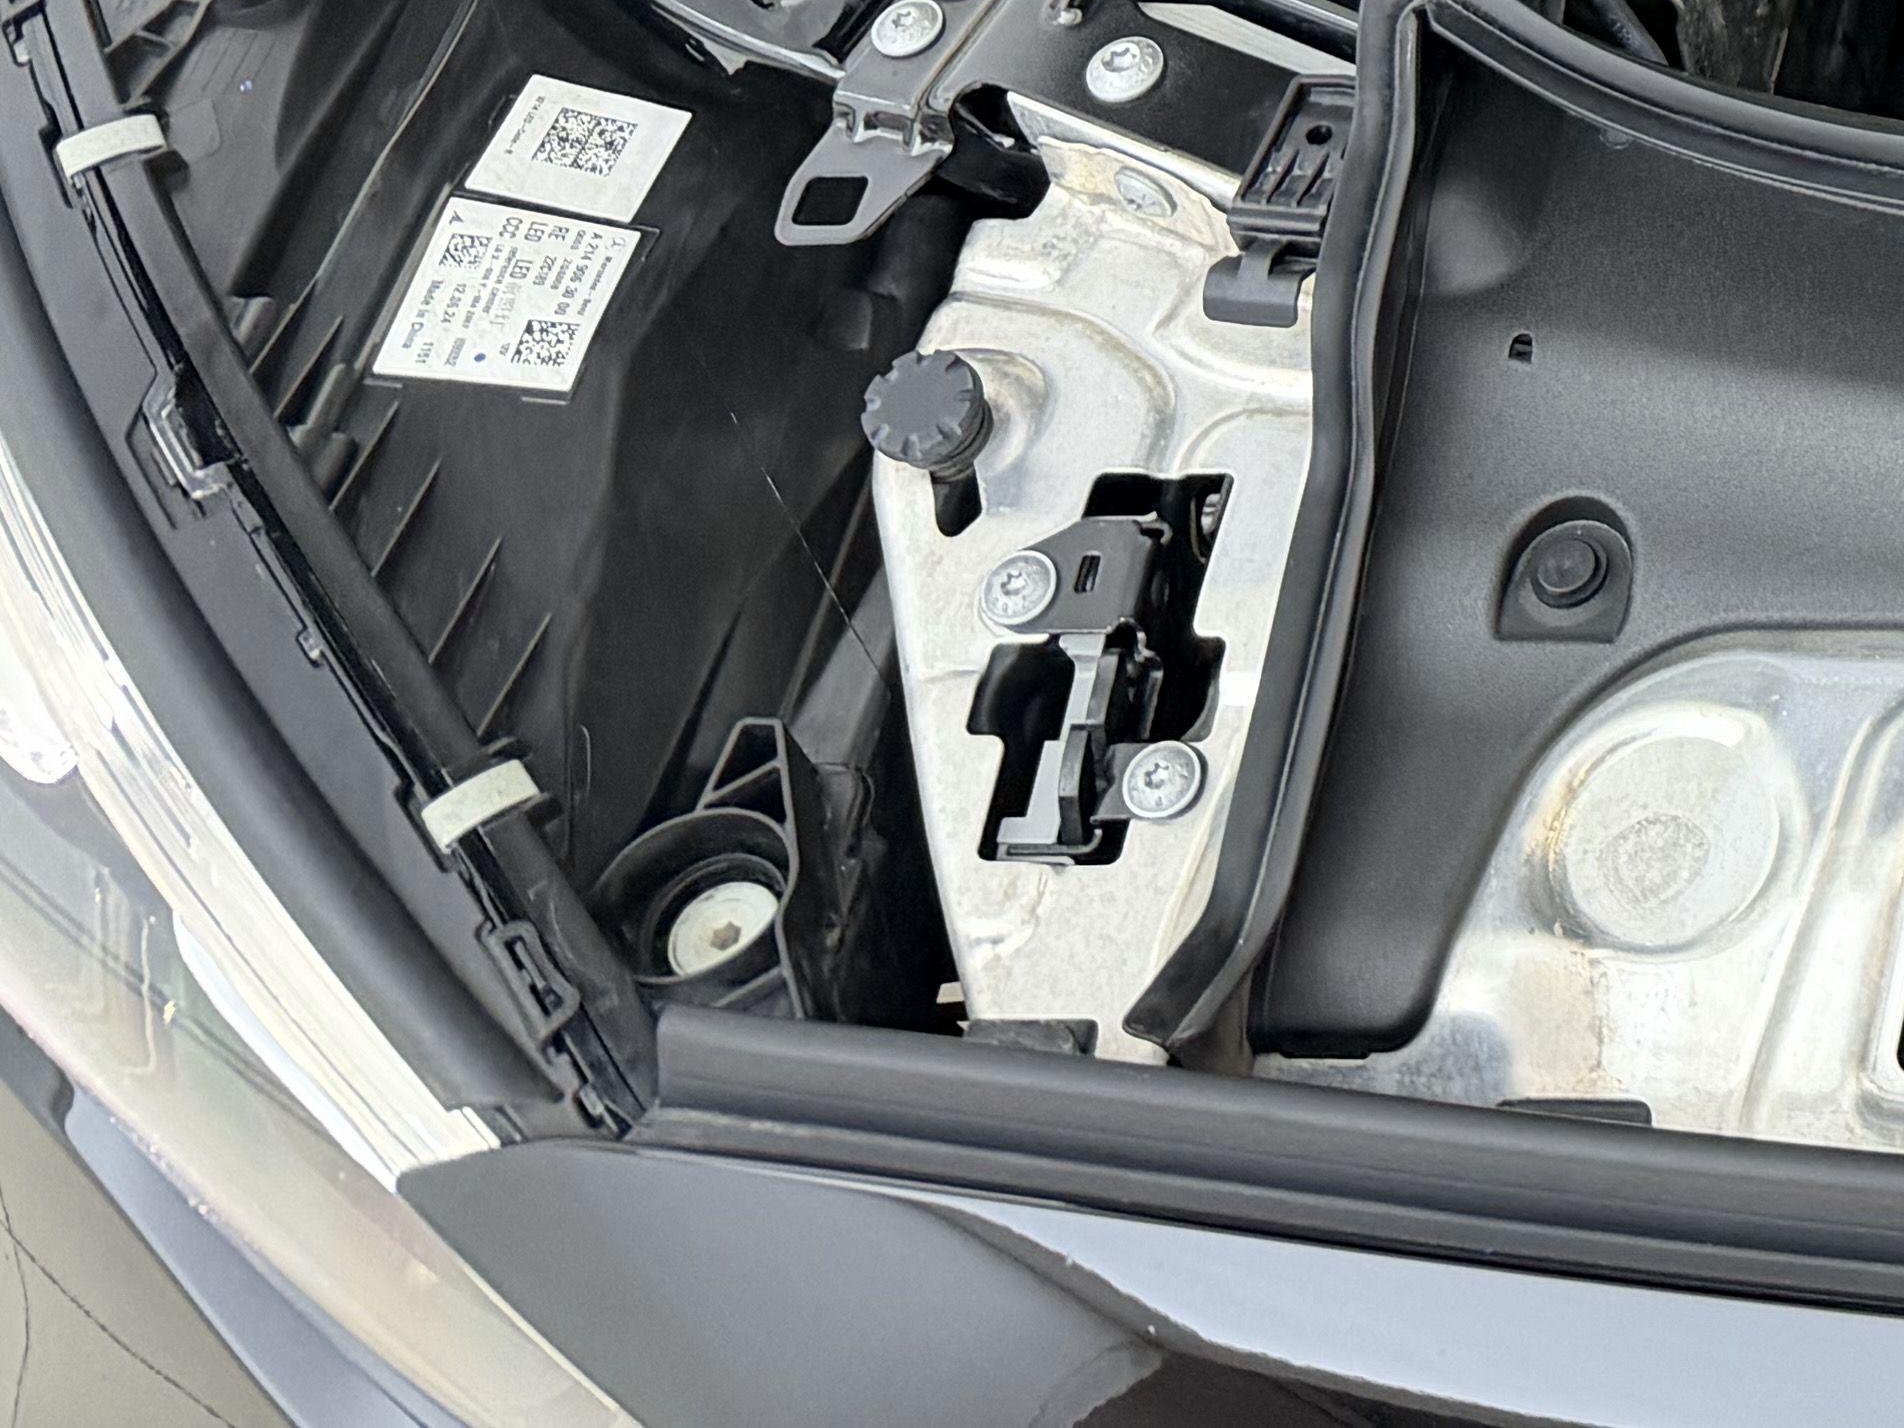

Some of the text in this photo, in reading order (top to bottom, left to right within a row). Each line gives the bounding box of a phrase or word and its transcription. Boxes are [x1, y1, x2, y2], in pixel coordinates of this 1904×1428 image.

[497, 215, 523, 239] CCC
[522, 220, 548, 243] LED
[578, 241, 598, 261] 214
[508, 258, 533, 280] LED
[419, 278, 444, 306] Made
[399, 321, 425, 350] China
